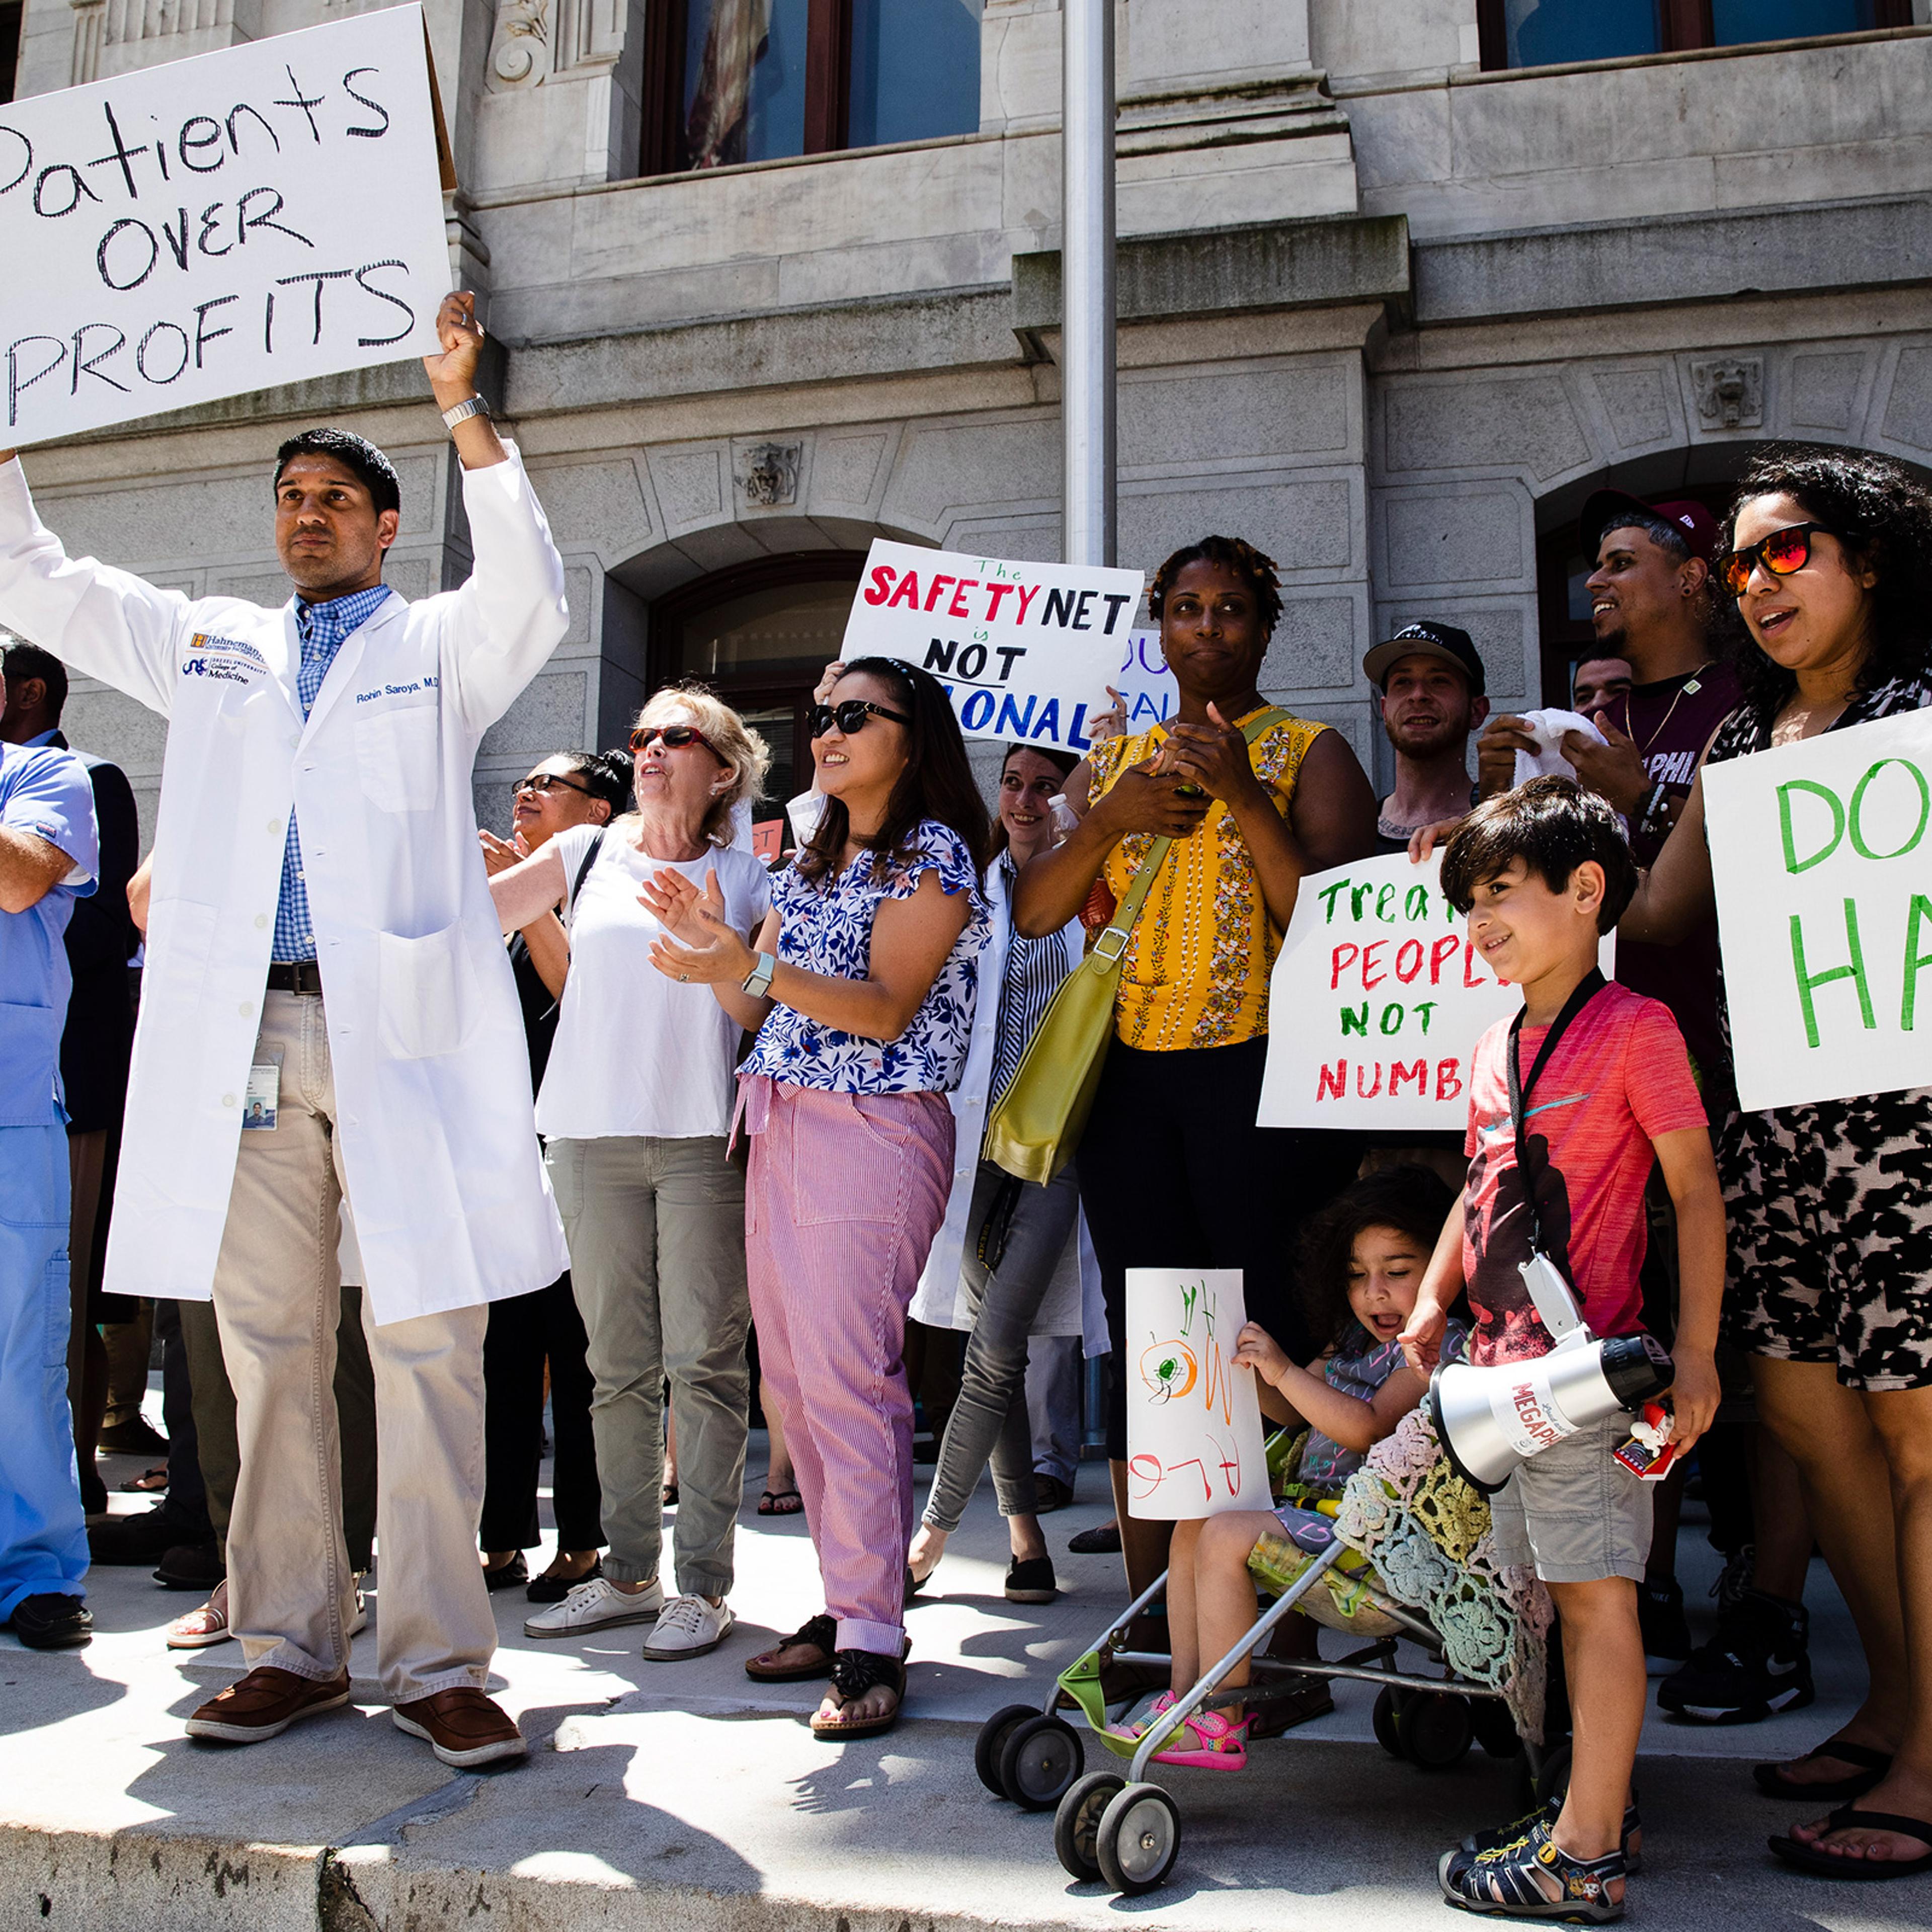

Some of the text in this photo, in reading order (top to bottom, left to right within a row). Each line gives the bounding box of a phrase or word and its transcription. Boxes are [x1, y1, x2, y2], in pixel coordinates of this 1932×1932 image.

[97, 187, 314, 290] OVER
[5, 260, 415, 427] PROFITS
[973, 559, 1022, 580] The
[864, 565, 1131, 635] SAFETY NET
[973, 626, 989, 641] is
[208, 670, 249, 685] Medicine
[922, 638, 1027, 681] NOT
[356, 689, 382, 703] Rohin
[942, 684, 1091, 751] ONAL
[1775, 758, 1930, 875] DO
[1330, 934, 1511, 991] PEOPL
[1339, 1001, 1439, 1037] NOT
[1316, 1058, 1463, 1102] NUMB
